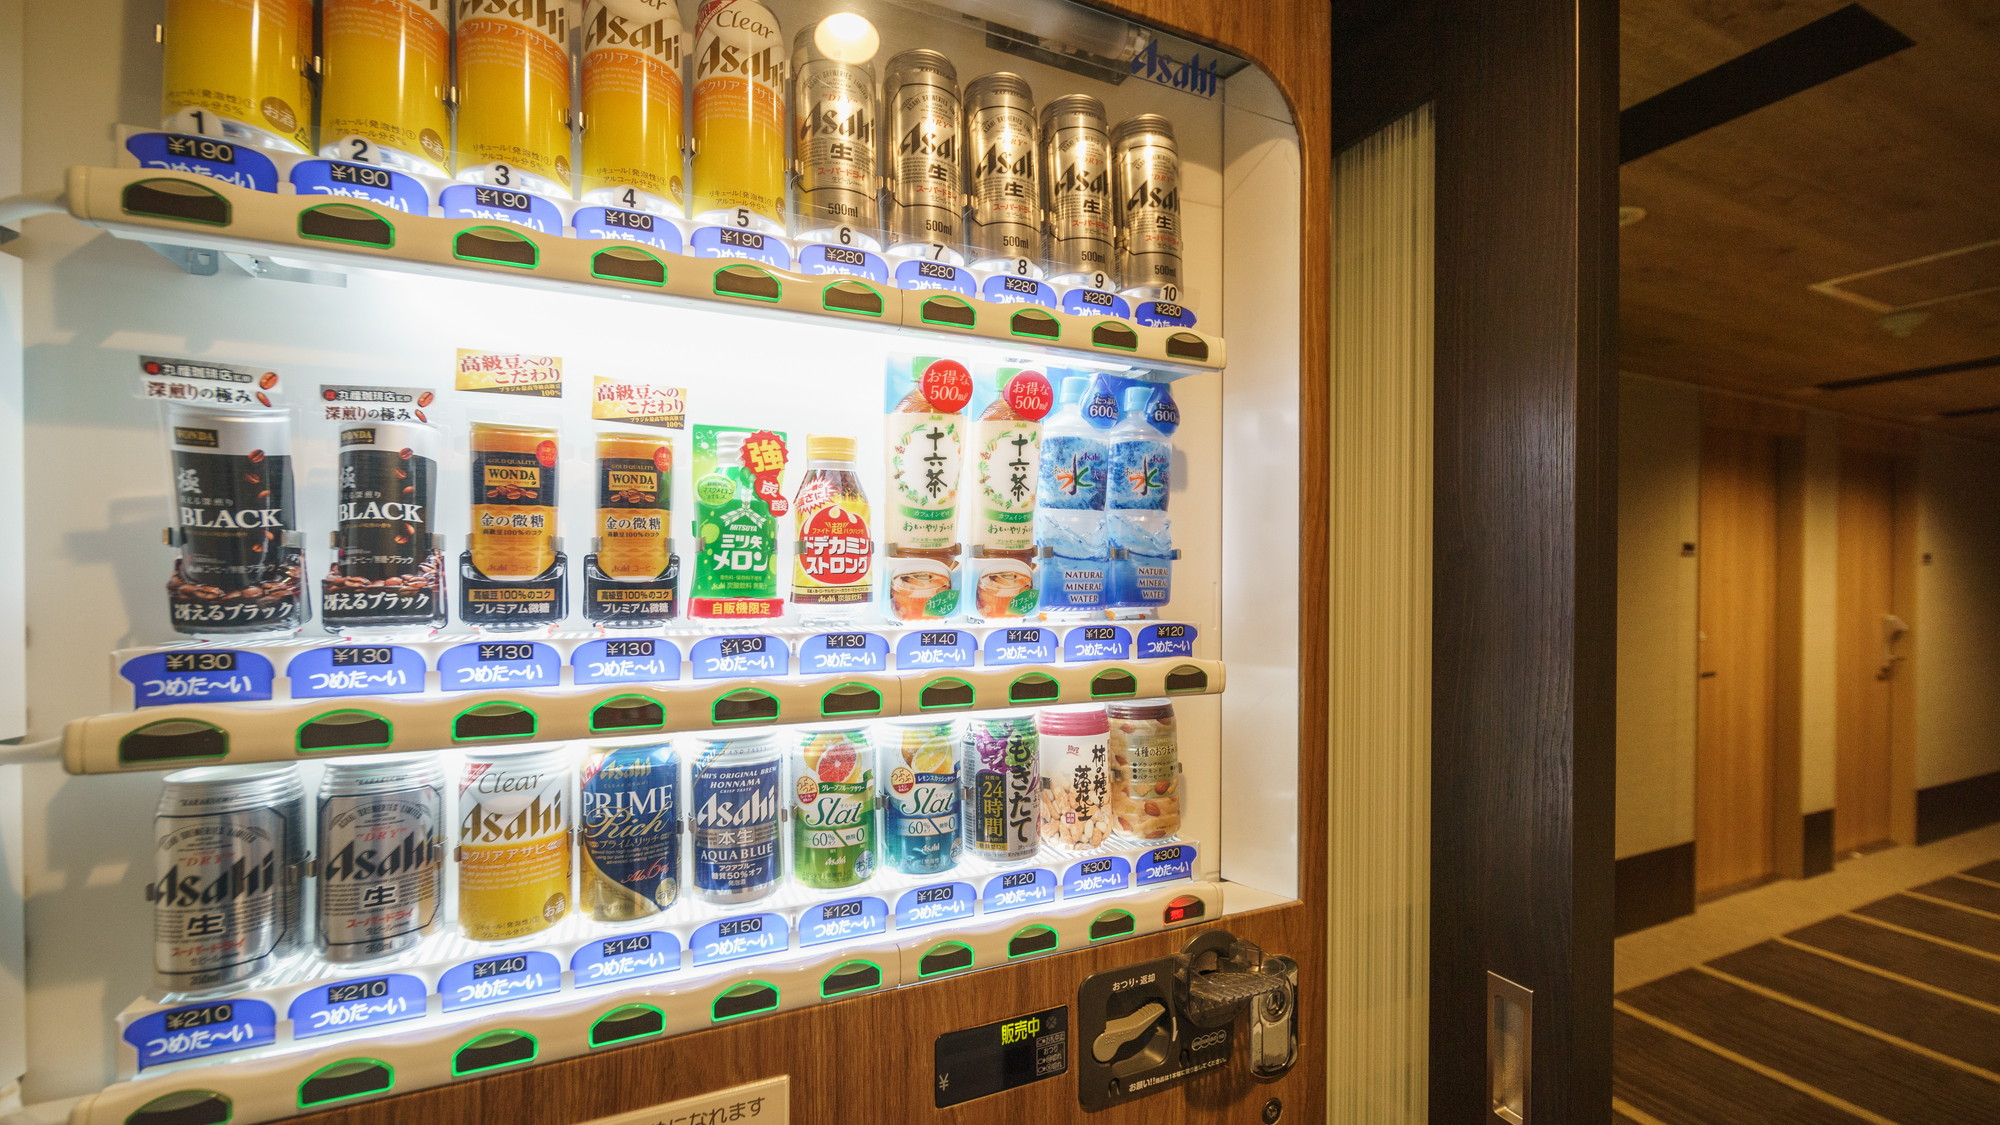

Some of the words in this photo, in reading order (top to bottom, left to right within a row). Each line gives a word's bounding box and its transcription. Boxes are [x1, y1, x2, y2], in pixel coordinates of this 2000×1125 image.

[716, 9, 775, 39] Clear
[585, 6, 679, 69] Asahi
[697, 36, 784, 93] Asahi
[1131, 40, 1218, 97] Asahi
[190, 111, 203, 134] 1
[800, 100, 875, 148] Asahi
[167, 136, 233, 162] ¥190
[352, 140, 368, 161] 2
[830, 143, 853, 161] 生
[332, 163, 390, 187] ¥190
[495, 165, 510, 186] 3
[928, 163, 947, 182] 生
[622, 189, 636, 207] 4
[1004, 181, 1025, 198] 生
[477, 189, 528, 210] ¥190
[1083, 199, 1101, 215] 生
[737, 209, 749, 227] 5
[828, 203, 858, 218] 500ml
[606, 211, 652, 230] ¥190
[925, 219, 952, 236] 500ml
[1156, 215, 1173, 230] 生
[721, 229, 763, 247] ¥190
[840, 227, 851, 244] 6
[1003, 236, 1029, 249] 500ml
[826, 248, 864, 265] ¥280
[933, 244, 943, 260] 7
[1082, 251, 1105, 264] 500ml
[920, 263, 954, 280] ¥280
[1018, 259, 1027, 274] 8
[1155, 264, 1176, 278] 500ml
[1005, 276, 1037, 294] ¥280
[1095, 273, 1103, 288] 9
[1083, 290, 1113, 306] ¥280
[1163, 286, 1177, 302] 10
[1155, 304, 1182, 317] ¥280
[461, 354, 553, 373] 高級豆への
[495, 367, 560, 384] こだわり
[927, 369, 970, 386] お得な
[147, 382, 252, 403] 深煎りの極み
[597, 384, 679, 401] 高級豆への
[1012, 381, 1050, 396] お得な
[325, 406, 411, 421] 深煎りの極み
[626, 399, 684, 414] こだわり
[747, 439, 783, 472] 強
[923, 427, 948, 498] 十六茶
[488, 468, 536, 480] WONDA
[1008, 434, 1030, 502] 十六茶
[1057, 453, 1095, 496] 水
[1129, 455, 1164, 496] 水
[612, 473, 654, 485] WONDA
[180, 507, 284, 528] BLACK
[339, 502, 424, 523] BLACK
[481, 513, 544, 527] 金の微糖
[913, 509, 949, 517] カフェインゼロ
[606, 517, 661, 529] 金の微糖
[729, 524, 757, 532] MITSUYA
[721, 534, 763, 550] 三ツ矢
[804, 535, 870, 555] ドデカミン
[713, 550, 768, 571] メロン
[806, 557, 868, 574] ストロング
[1064, 571, 1103, 579] NATURAL
[473, 590, 550, 600] 高級豆100%のコク
[601, 591, 669, 600] 高級豆100%のコク
[1064, 583, 1103, 591] MINERAL
[1142, 590, 1165, 598] WATER
[324, 592, 430, 611] 冴えるブラック
[602, 603, 668, 613] プレミアム微糖
[927, 591, 957, 609] カフェイン
[1010, 591, 1037, 608] カフェイン
[174, 603, 293, 621] 冴えるブラック
[474, 604, 550, 614] プレミアム微糖
[712, 602, 771, 615] 自販機限定
[939, 604, 953, 614] ゼロ
[1020, 604, 1033, 613] ゼロ
[922, 633, 956, 646] ¥140
[1008, 630, 1039, 642] ¥140
[1085, 628, 1115, 640] ¥120
[1157, 626, 1185, 637] ¥120
[607, 641, 652, 656] ¥130
[722, 638, 763, 655] ¥130
[828, 634, 864, 647] ¥130
[333, 648, 391, 664] ¥130
[480, 644, 532, 660] ¥130
[167, 653, 232, 670] ¥130
[600, 757, 652, 780] Asahi
[720, 770, 758, 779] ORIGINAL
[760, 766, 778, 775] BREW
[478, 771, 545, 794] Clear
[710, 778, 760, 788] HONNAMA
[821, 784, 865, 792] グレープフルーツサワー
[1009, 735, 1033, 843] もぎたて
[583, 784, 673, 819] PRIME
[901, 787, 954, 815] Slat
[1073, 765, 1095, 821] 落花生
[697, 785, 775, 827] Asahi
[805, 797, 862, 826] Slat
[461, 789, 562, 843] Asahi
[585, 801, 673, 839] Rich
[718, 830, 754, 845] 本生
[325, 826, 433, 882] Asahi
[701, 850, 738, 863] AQUA
[740, 842, 773, 860] BLUE
[921, 843, 940, 852] Asahi
[1154, 848, 1180, 862] ¥300
[719, 863, 756, 872] アクアブルー
[825, 855, 846, 865] Asahi
[1081, 860, 1111, 874] ¥300
[145, 850, 274, 907] Asahi
[711, 867, 763, 880] 糖質50%オフ
[1003, 872, 1035, 887] ¥120
[363, 886, 396, 908] 生
[918, 888, 951, 902] ¥120
[544, 898, 565, 917] お酒
[824, 903, 860, 919] ¥120
[187, 914, 225, 937] 生
[347, 908, 414, 929] スーパードライ
[720, 919, 761, 935] ¥150
[604, 936, 650, 956] ¥140
[475, 957, 526, 977] ¥140
[1112, 973, 1156, 991] おつり・返却
[329, 981, 387, 1002] ¥210
[167, 1005, 232, 1029] ¥210
[1001, 1017, 1040, 1045] 販売中
[1043, 1044, 1058, 1055] おつり
[939, 1072, 949, 1091] ¥
